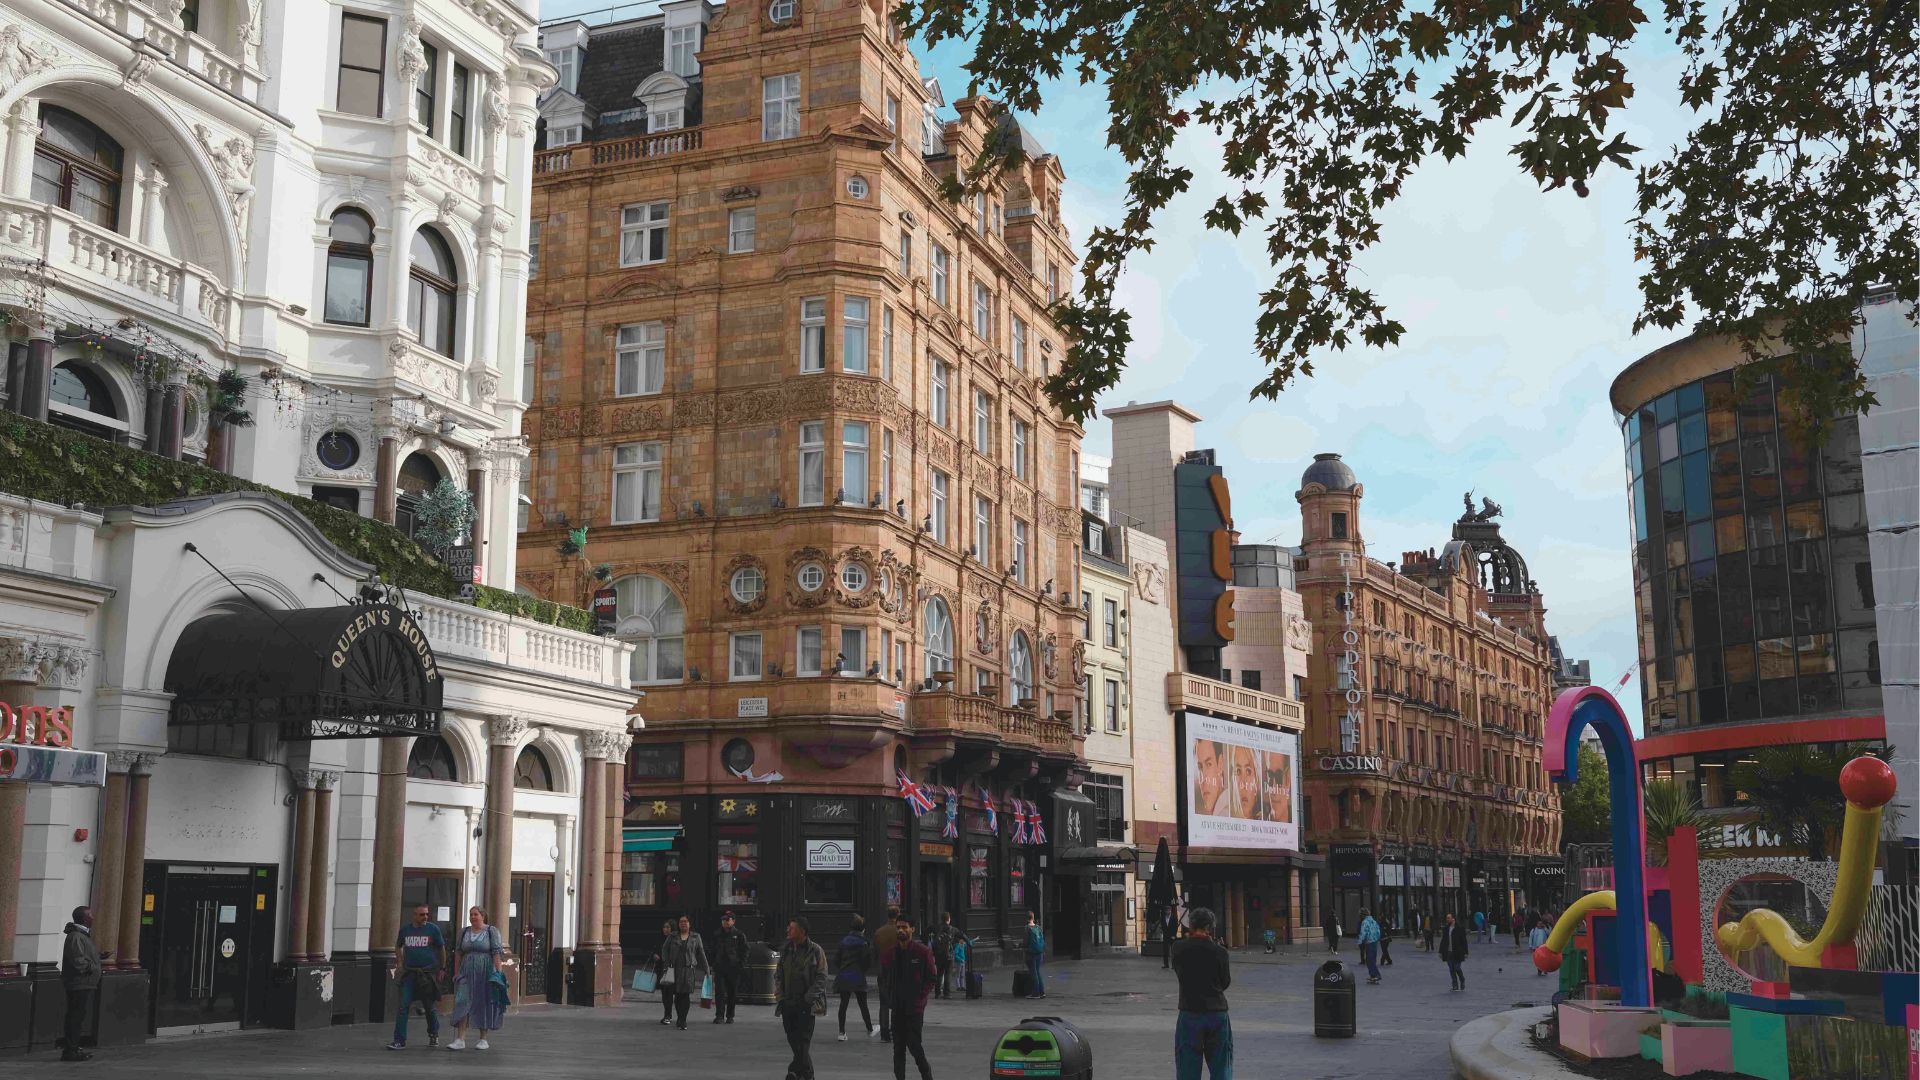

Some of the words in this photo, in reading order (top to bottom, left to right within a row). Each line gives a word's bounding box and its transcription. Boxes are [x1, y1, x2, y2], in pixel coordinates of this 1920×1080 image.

[450, 549, 473, 558] LIVE
[451, 565, 472, 577] BIG
[595, 597, 616, 606] SPORTS
[331, 609, 390, 668] QUEEN'S
[399, 616, 437, 683] HOUSE
[1339, 552, 1362, 744] HIPPODROME
[1319, 756, 1383, 772] CASINO
